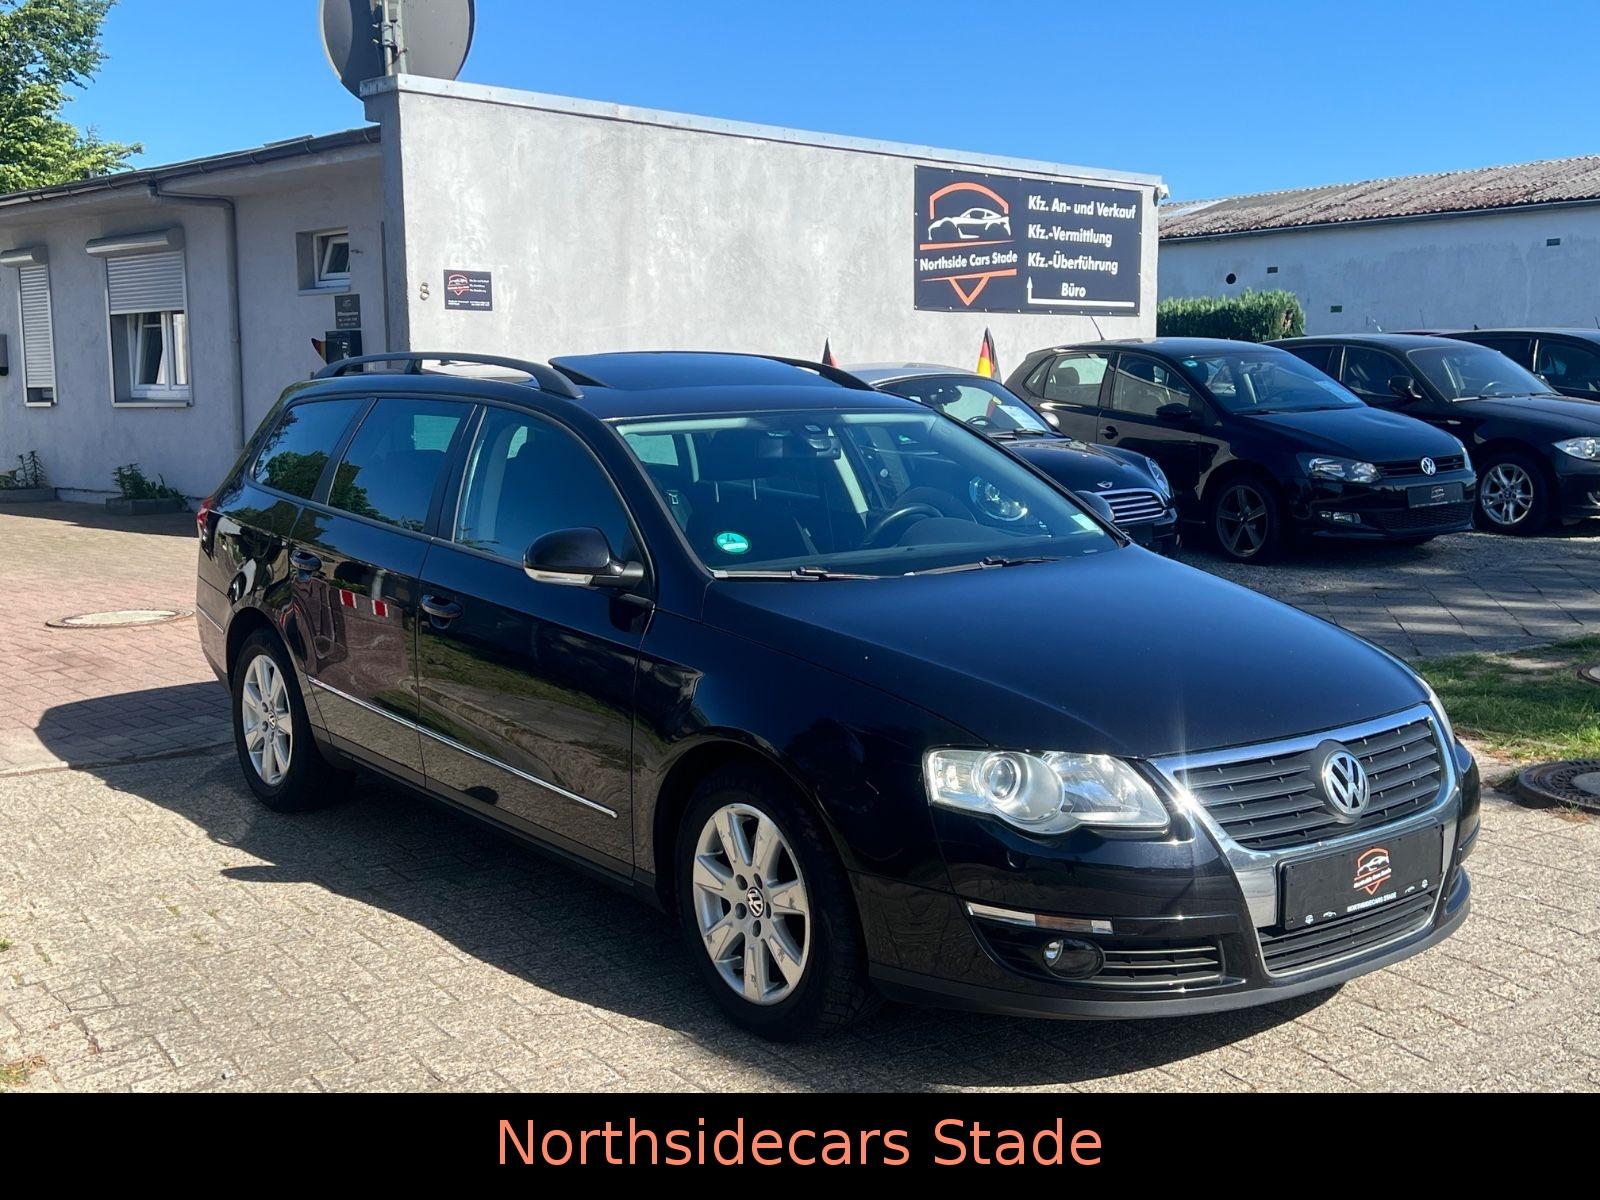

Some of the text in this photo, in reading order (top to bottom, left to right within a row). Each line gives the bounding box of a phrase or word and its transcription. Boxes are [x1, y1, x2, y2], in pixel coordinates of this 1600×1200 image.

[1028, 195, 1136, 219] Kfz. An- und Verkauf
[1028, 224, 1113, 247] Kfz.-Vermittlung
[919, 250, 1018, 271] Northside Cars Stade
[1028, 250, 1118, 275] Kfz.-Überführung
[420, 282, 429, 301] 8
[1061, 283, 1086, 297] Büro
